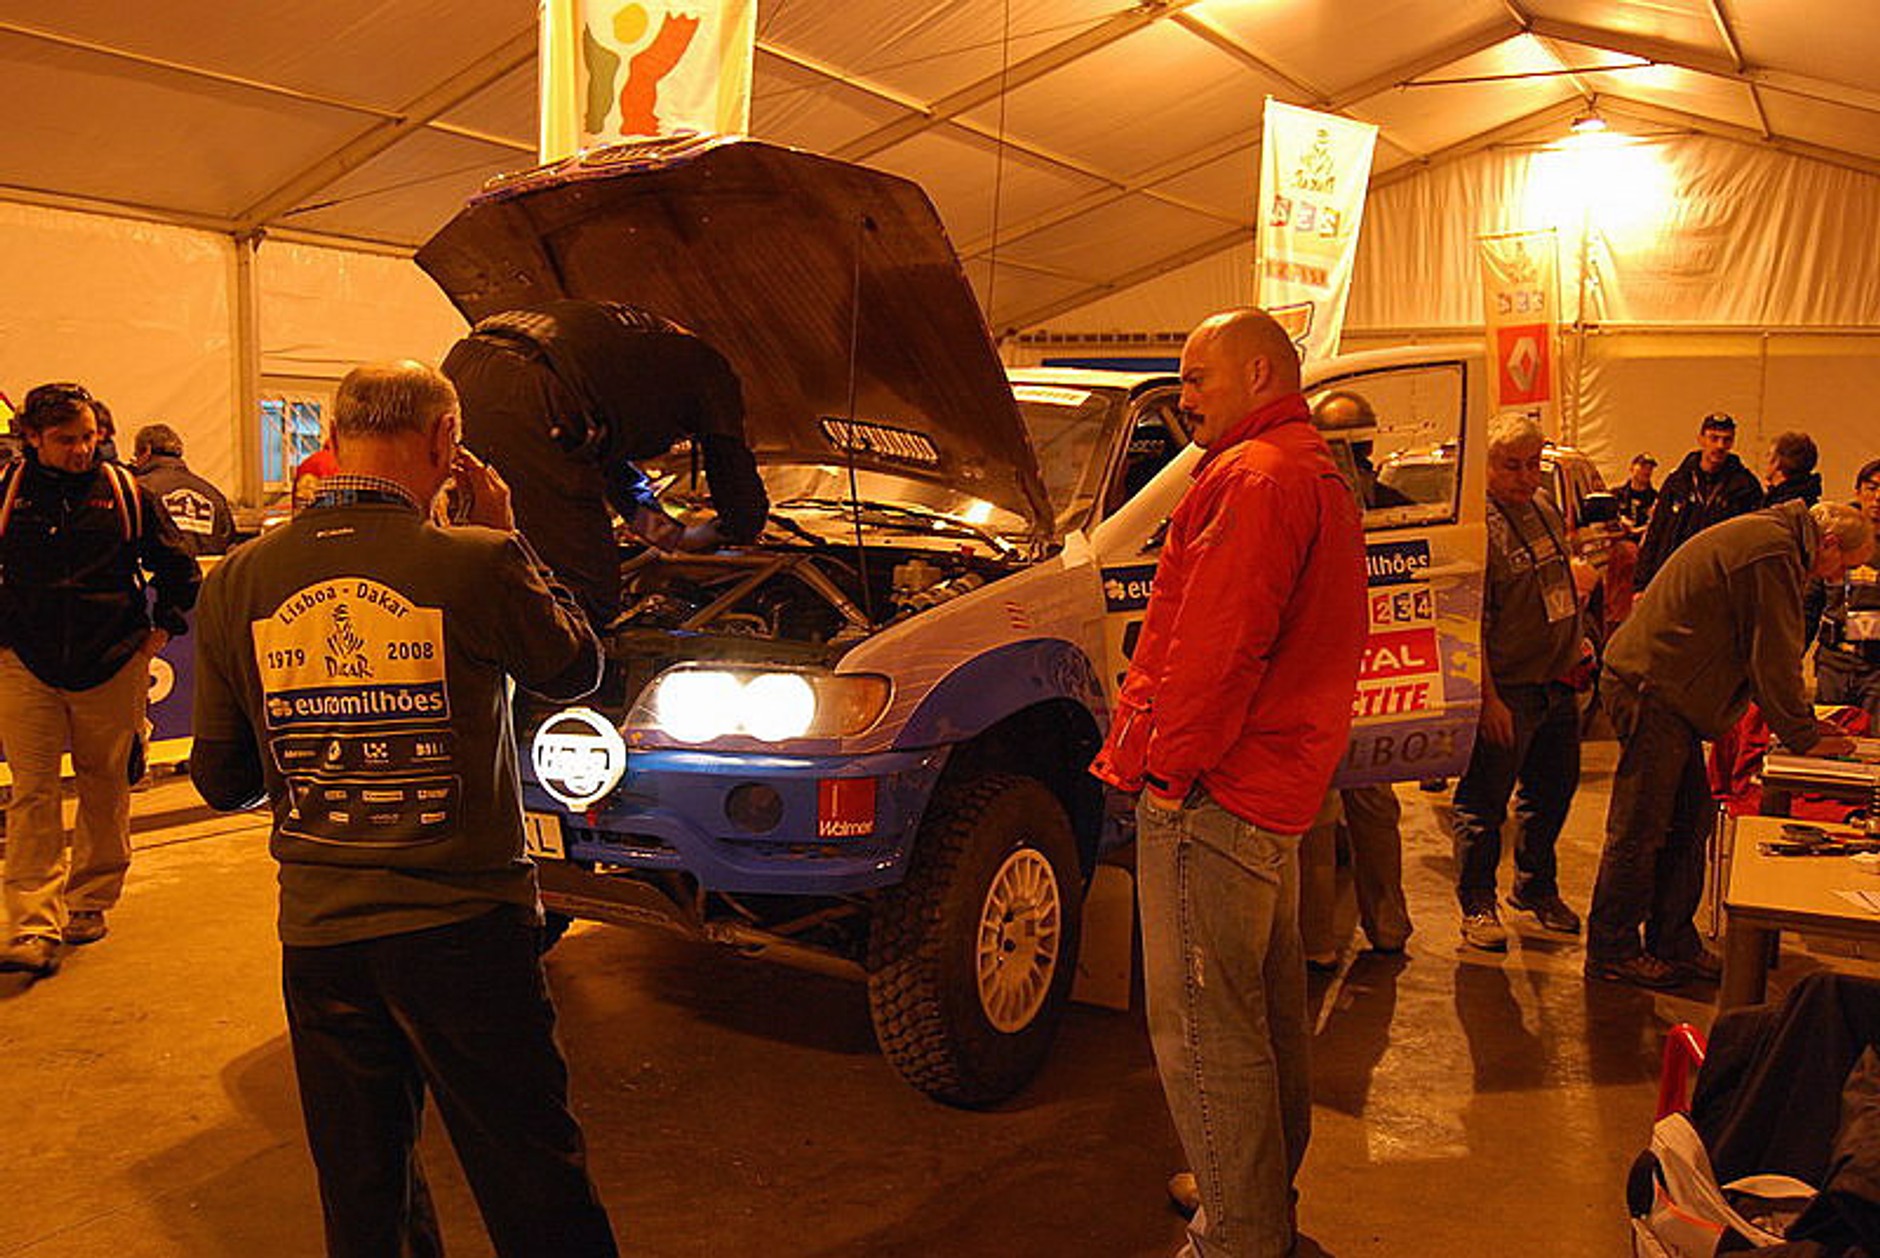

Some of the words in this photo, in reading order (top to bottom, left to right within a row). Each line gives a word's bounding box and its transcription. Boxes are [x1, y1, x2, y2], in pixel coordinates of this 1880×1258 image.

[278, 585, 337, 625] Lisboa
[356, 582, 410, 619] Dakar
[267, 648, 306, 669] 1979
[386, 641, 435, 661] 2008
[295, 688, 444, 716] euromilhões
